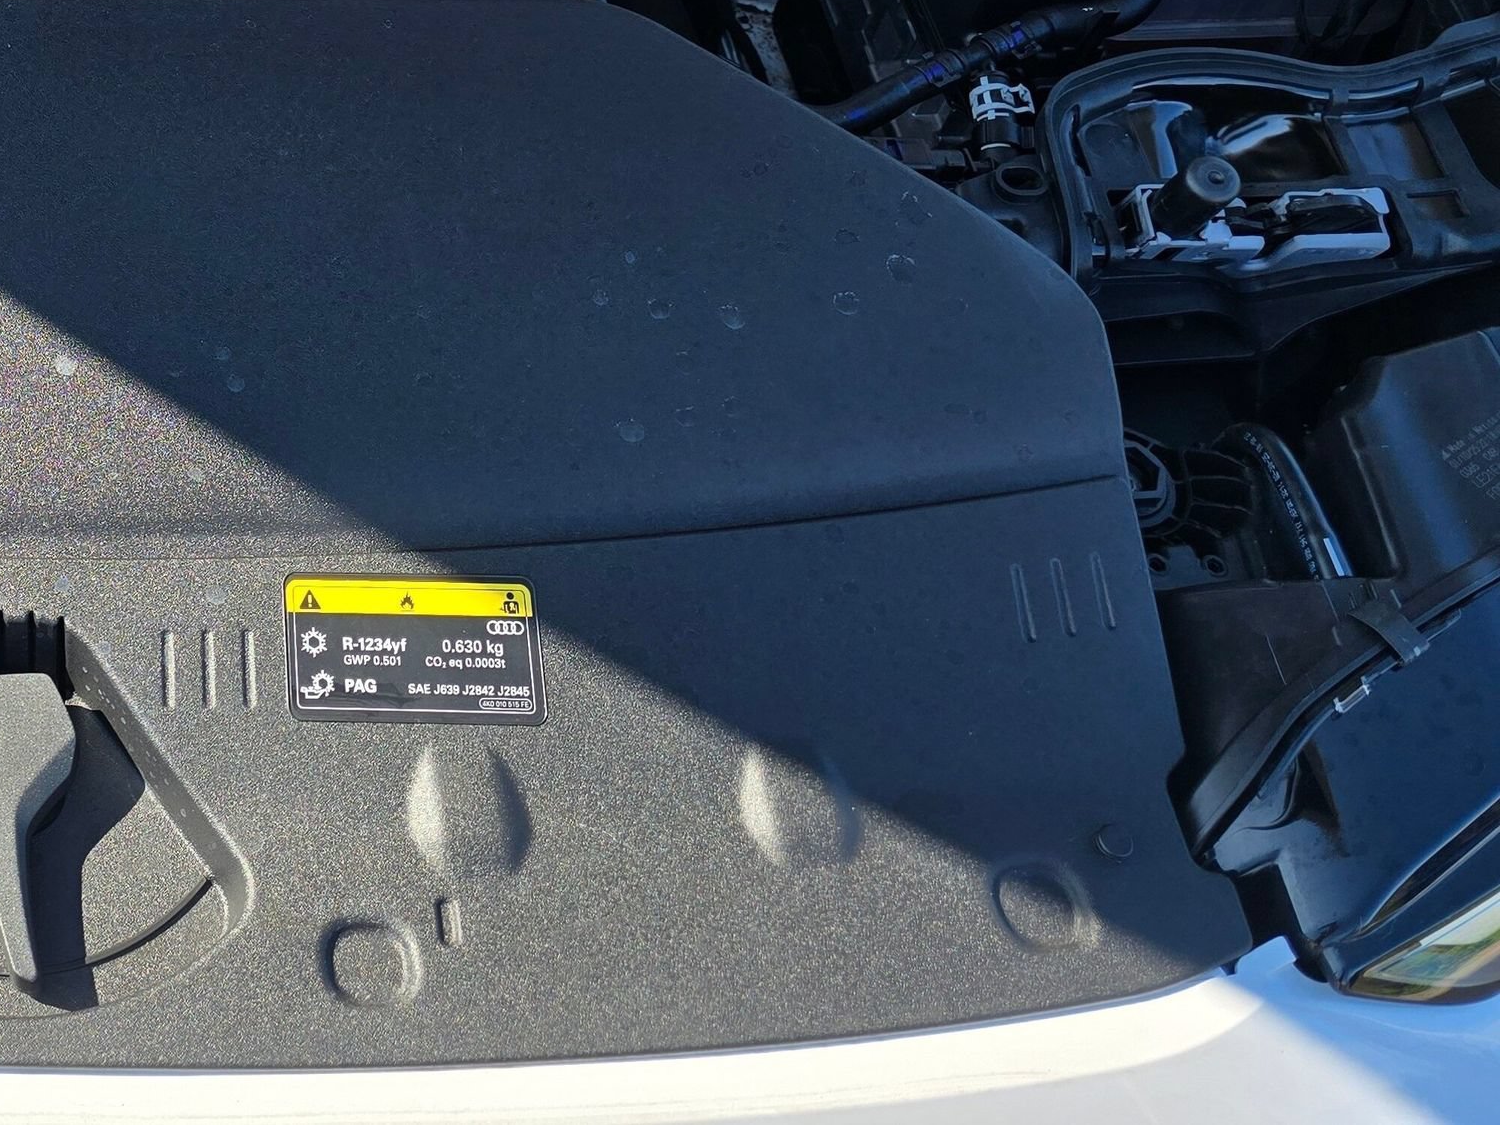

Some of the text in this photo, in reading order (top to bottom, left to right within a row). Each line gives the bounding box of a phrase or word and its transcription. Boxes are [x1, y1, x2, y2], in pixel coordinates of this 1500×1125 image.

[342, 637, 504, 656] R-1234yf 0.630 kg
[344, 655, 370, 666] GWP
[373, 655, 401, 666] 0.501
[449, 658, 463, 670] eq
[465, 657, 506, 669] 0.0003t
[345, 679, 377, 693] PAG
[408, 684, 530, 697] SAE J639 J2842 J2845
